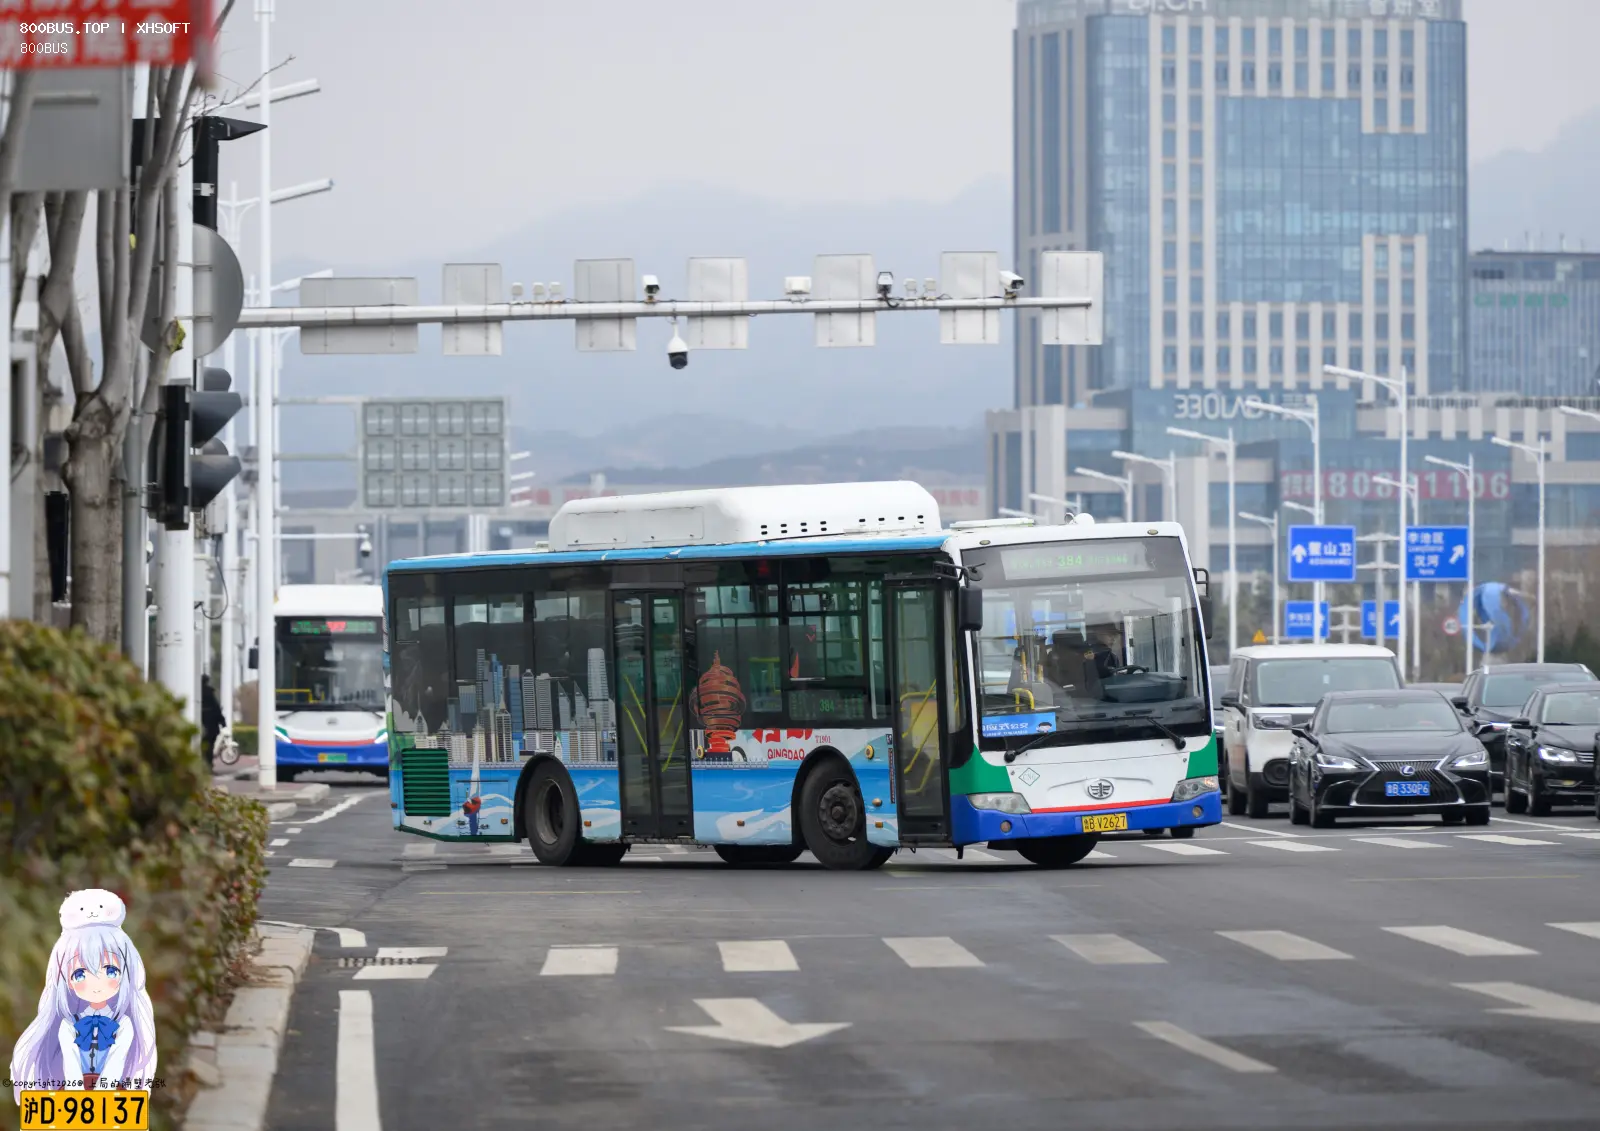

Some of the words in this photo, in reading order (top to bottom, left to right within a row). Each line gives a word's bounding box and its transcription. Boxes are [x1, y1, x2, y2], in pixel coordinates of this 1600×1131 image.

[1057, 555, 1083, 567] 384
[819, 699, 835, 712] 384
[767, 747, 805, 760] QINGDAO
